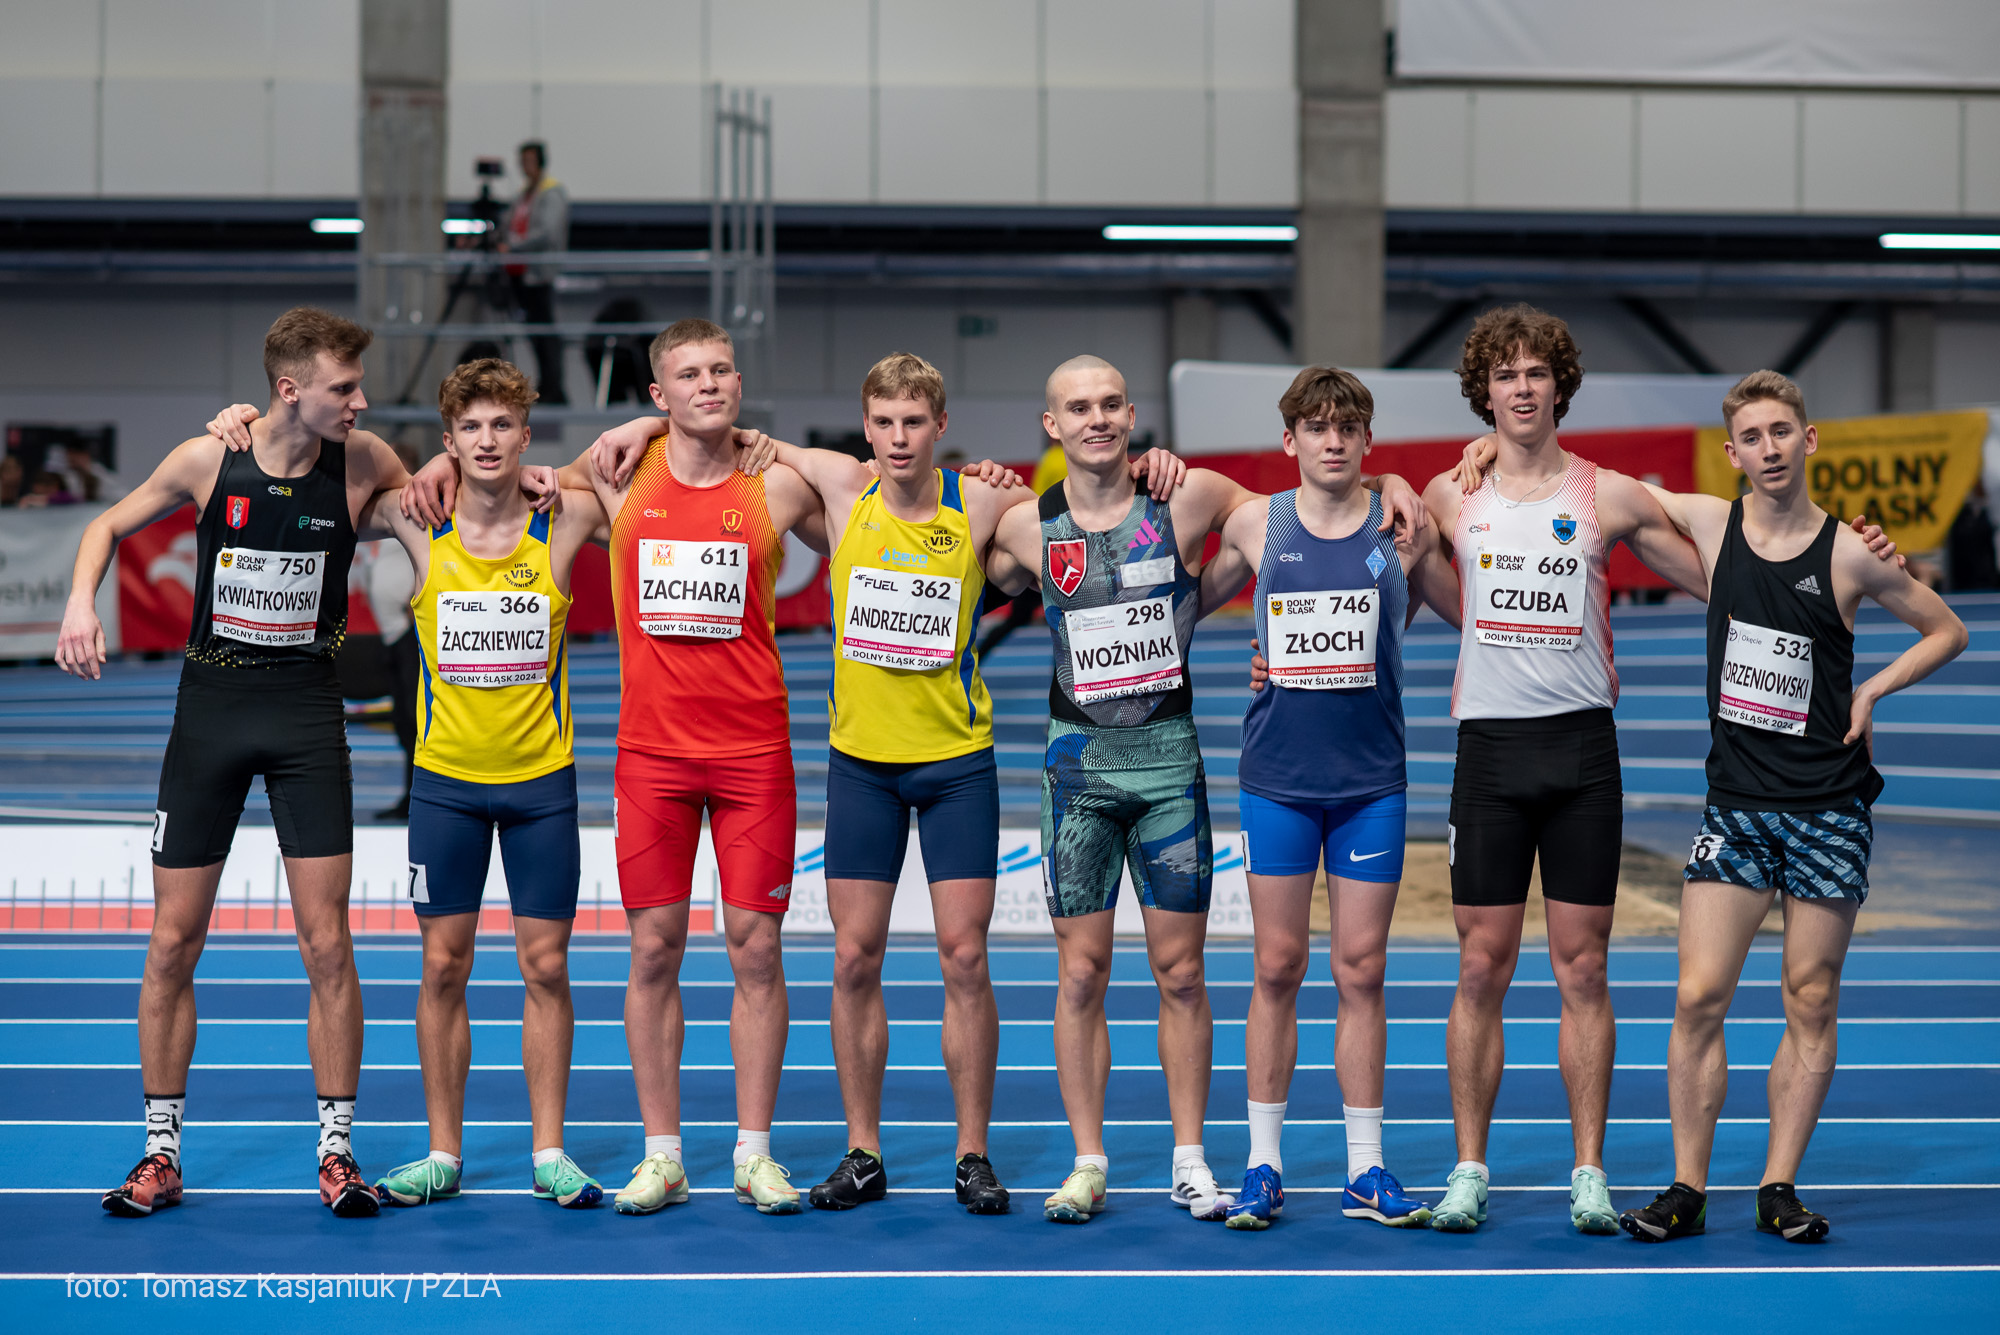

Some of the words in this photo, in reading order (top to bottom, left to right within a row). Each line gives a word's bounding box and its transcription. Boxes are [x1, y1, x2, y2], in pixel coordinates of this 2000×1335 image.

[1812, 453, 1948, 492] DOLNY
[644, 508, 667, 518] esa
[311, 518, 335, 528] FOBOS
[930, 536, 952, 546] VIS
[237, 555, 267, 564] DOLNY
[701, 548, 739, 567] 611
[892, 548, 928, 564] bevo
[1279, 552, 1303, 562] esa
[1496, 555, 1526, 563] DOLNY
[236, 562, 264, 572] ŚLĄSK
[280, 557, 316, 575] 750
[510, 569, 533, 579] VIS
[1496, 562, 1523, 571] ŚLĄSK
[1538, 557, 1578, 576] 669
[643, 580, 740, 604] ZACHARA
[864, 578, 898, 592] FUEL
[911, 579, 951, 600] 362
[1795, 584, 1821, 595] adidas
[218, 584, 317, 611] KWIATKOWSKI
[500, 596, 540, 614] 366
[1330, 595, 1370, 614] 746
[1490, 588, 1568, 613] CZUBA
[453, 602, 487, 612] FUEL
[1126, 603, 1165, 626] 298
[1287, 605, 1315, 615] ŚLĄSK
[679, 622, 708, 634] ŚLĄSK
[710, 626, 732, 635] 2024
[850, 606, 952, 637] ANDRZEJCZAK
[224, 626, 253, 639] DOLNY
[255, 632, 284, 643] ŚLĄSK
[286, 633, 305, 642] 2024
[442, 626, 544, 651] ŻACZKIEWICZ
[1285, 630, 1364, 654] ZŁOCH
[1485, 633, 1513, 642] DOLNY
[1516, 634, 1546, 645] ŚLĄSK
[1742, 635, 1762, 645] Okęcie
[1075, 636, 1174, 670] WOŹNIAK
[1772, 636, 1811, 662] 532
[853, 650, 883, 661] DOLNY
[886, 654, 916, 666] ŚLĄSK
[918, 659, 942, 667] 2024
[483, 674, 512, 684] ŚLĄSK
[515, 673, 536, 681] 2024
[1152, 681, 1173, 690] 2024
[1316, 676, 1345, 686] ŚLĄSK
[1740, 711, 1769, 725] ŚLĄSK
[1771, 720, 1794, 730] 2024
[1695, 836, 1715, 862] 6
[409, 866, 418, 898] 7
